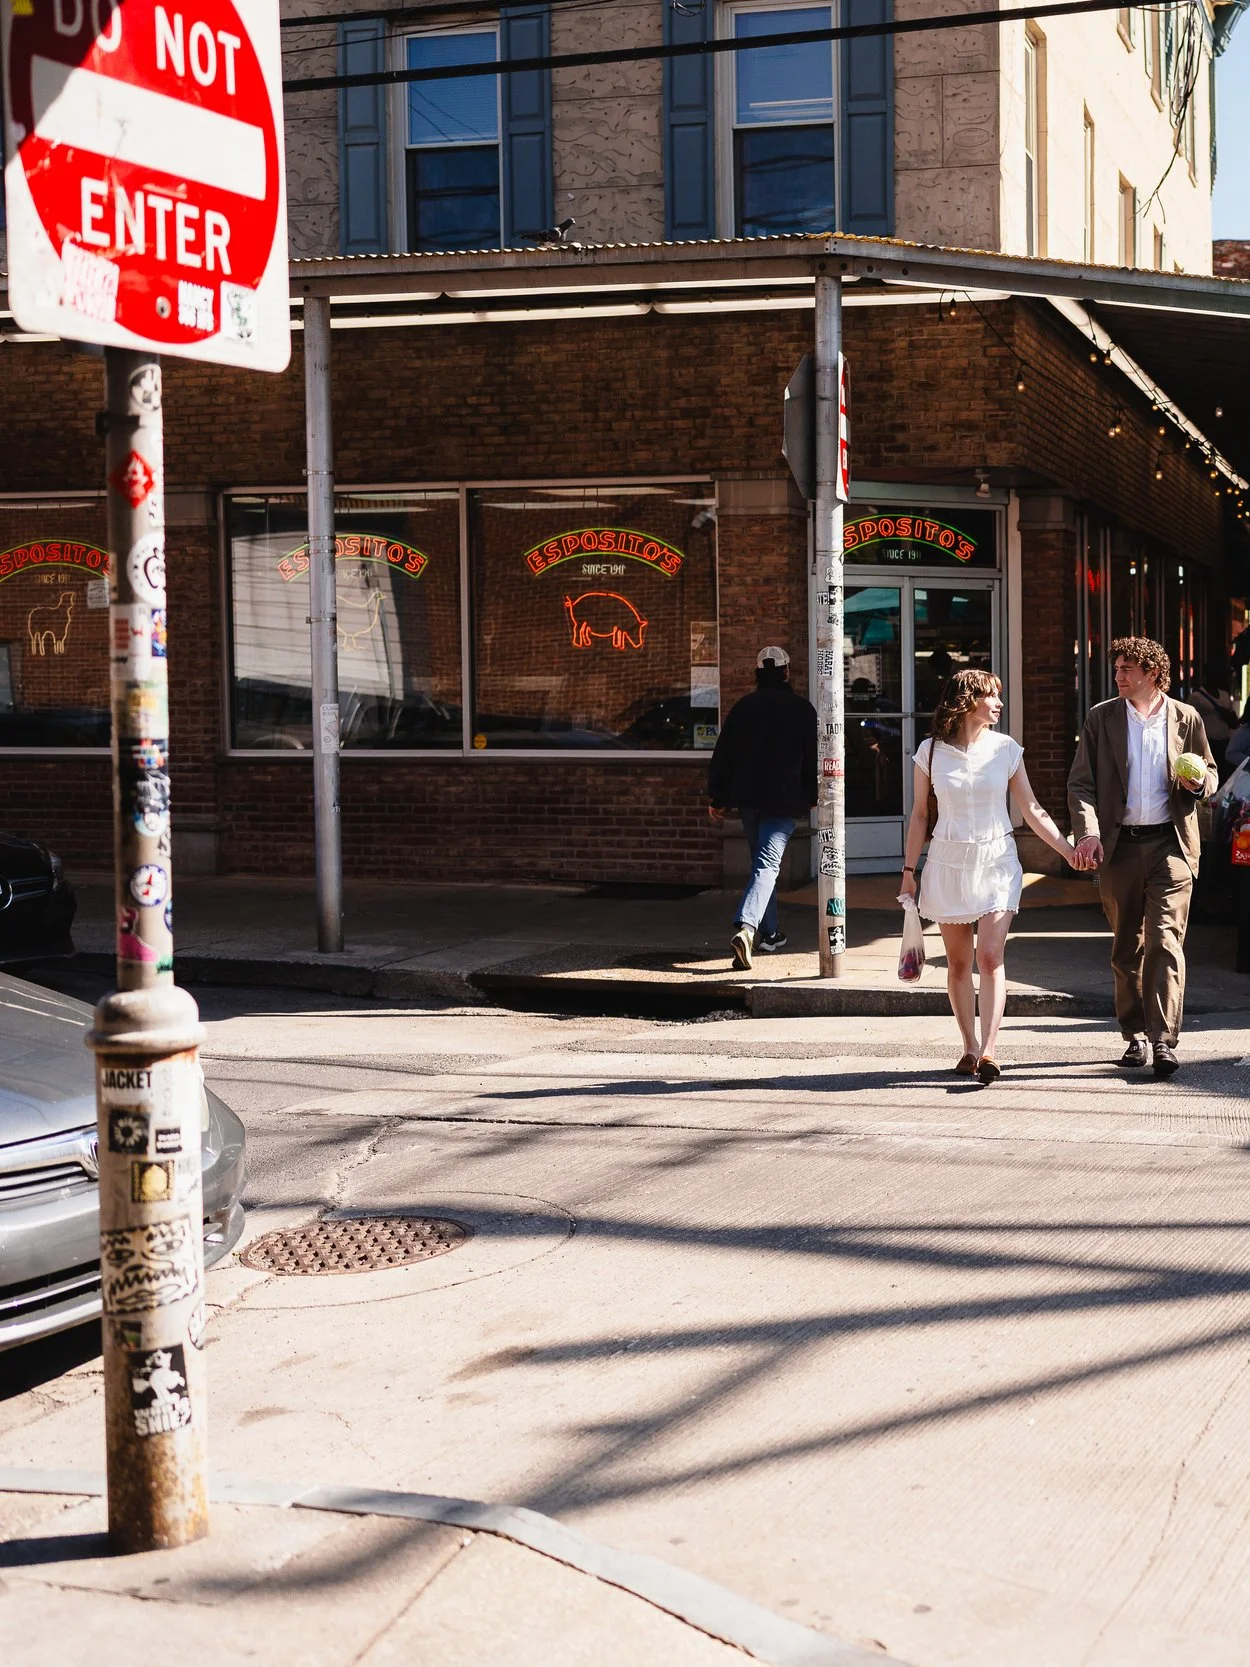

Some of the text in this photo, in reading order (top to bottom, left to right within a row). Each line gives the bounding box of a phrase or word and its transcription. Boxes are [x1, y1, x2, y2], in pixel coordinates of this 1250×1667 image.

[54, 0, 242, 95] DO NOT
[80, 176, 232, 276] ENTER
[0, 543, 110, 577] SPOSITO'
[278, 536, 424, 581] ESOSITO'S
[527, 531, 682, 573] ESPOSITO'S
[843, 518, 975, 560] SPOSITO'S
[818, 828, 835, 844] ATE!
[102, 1070, 152, 1089] JACKET
